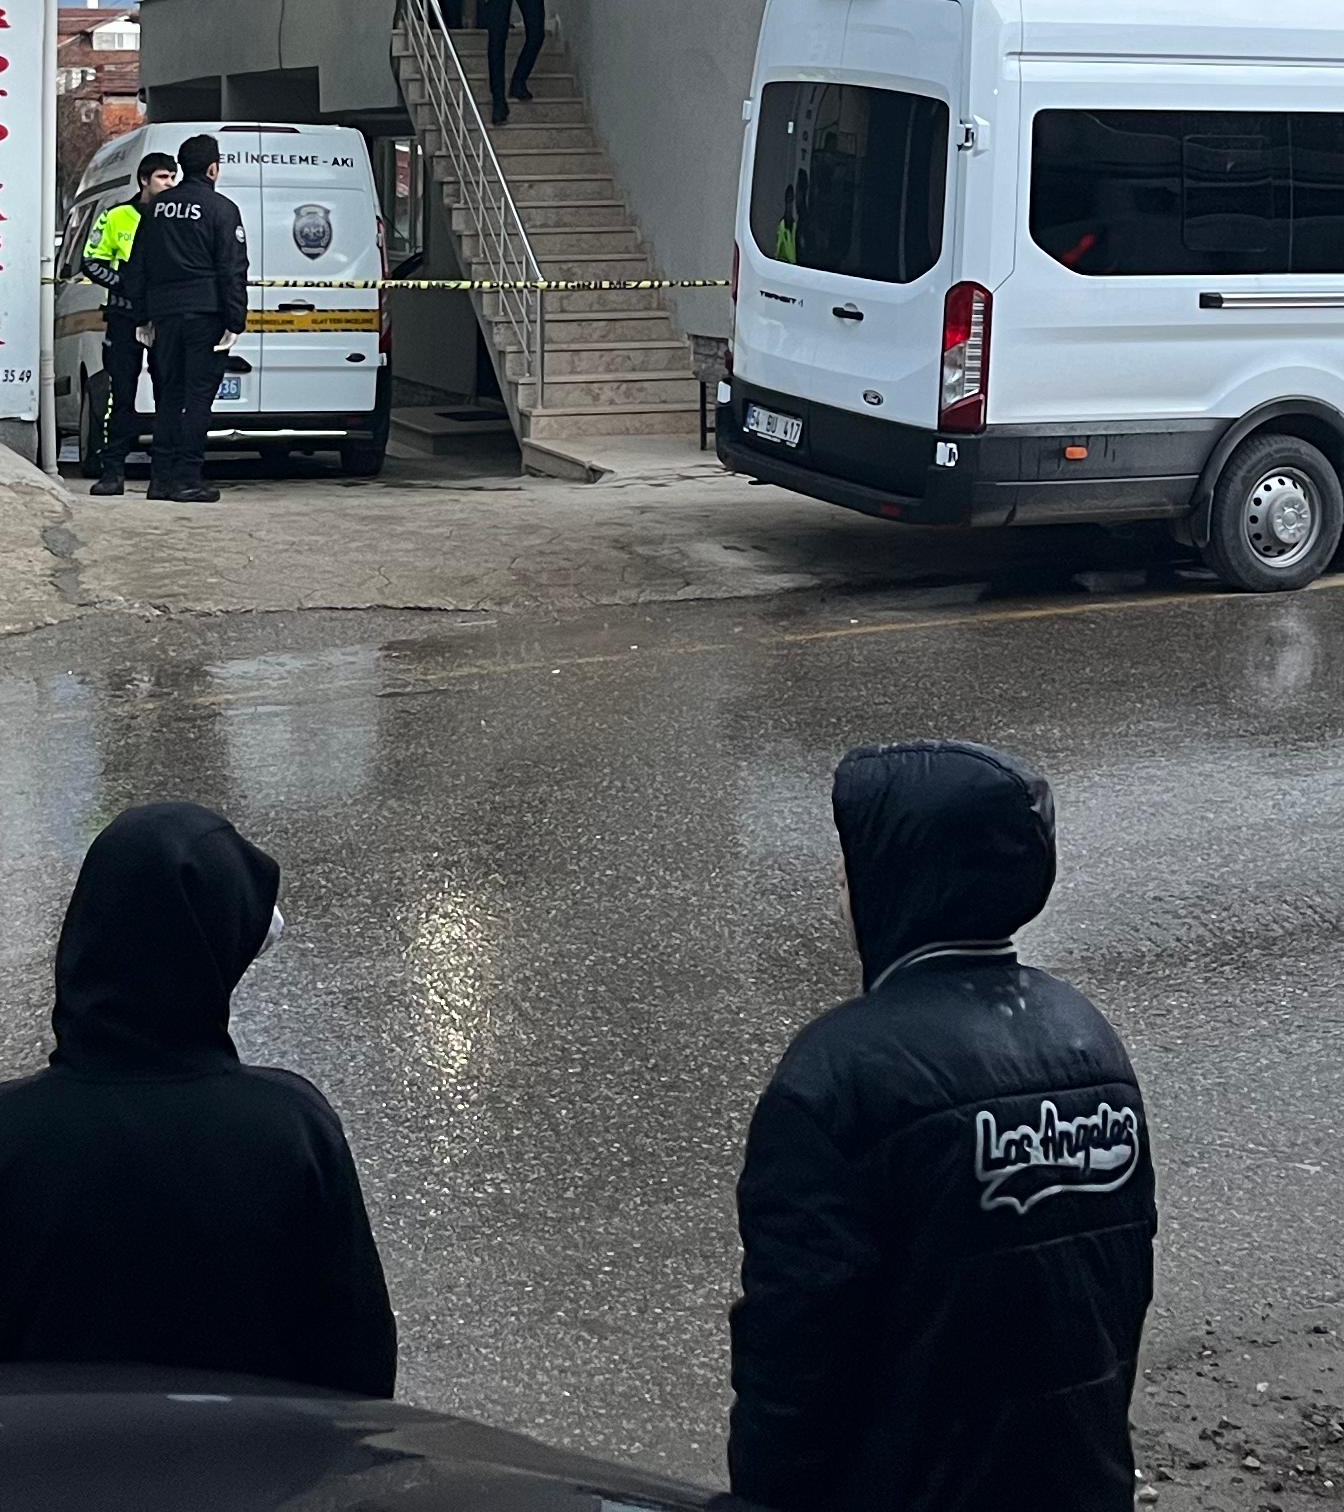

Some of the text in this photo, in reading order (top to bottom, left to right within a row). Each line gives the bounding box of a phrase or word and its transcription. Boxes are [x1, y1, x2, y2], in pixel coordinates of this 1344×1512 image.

[245, 151, 319, 166] İNCELEME
[331, 156, 355, 169] AKİ
[2, 369, 16, 383] 35
[18, 369, 32, 384] 49
[217, 379, 238, 395] 36
[979, 1103, 1136, 1174] Los Angeles
